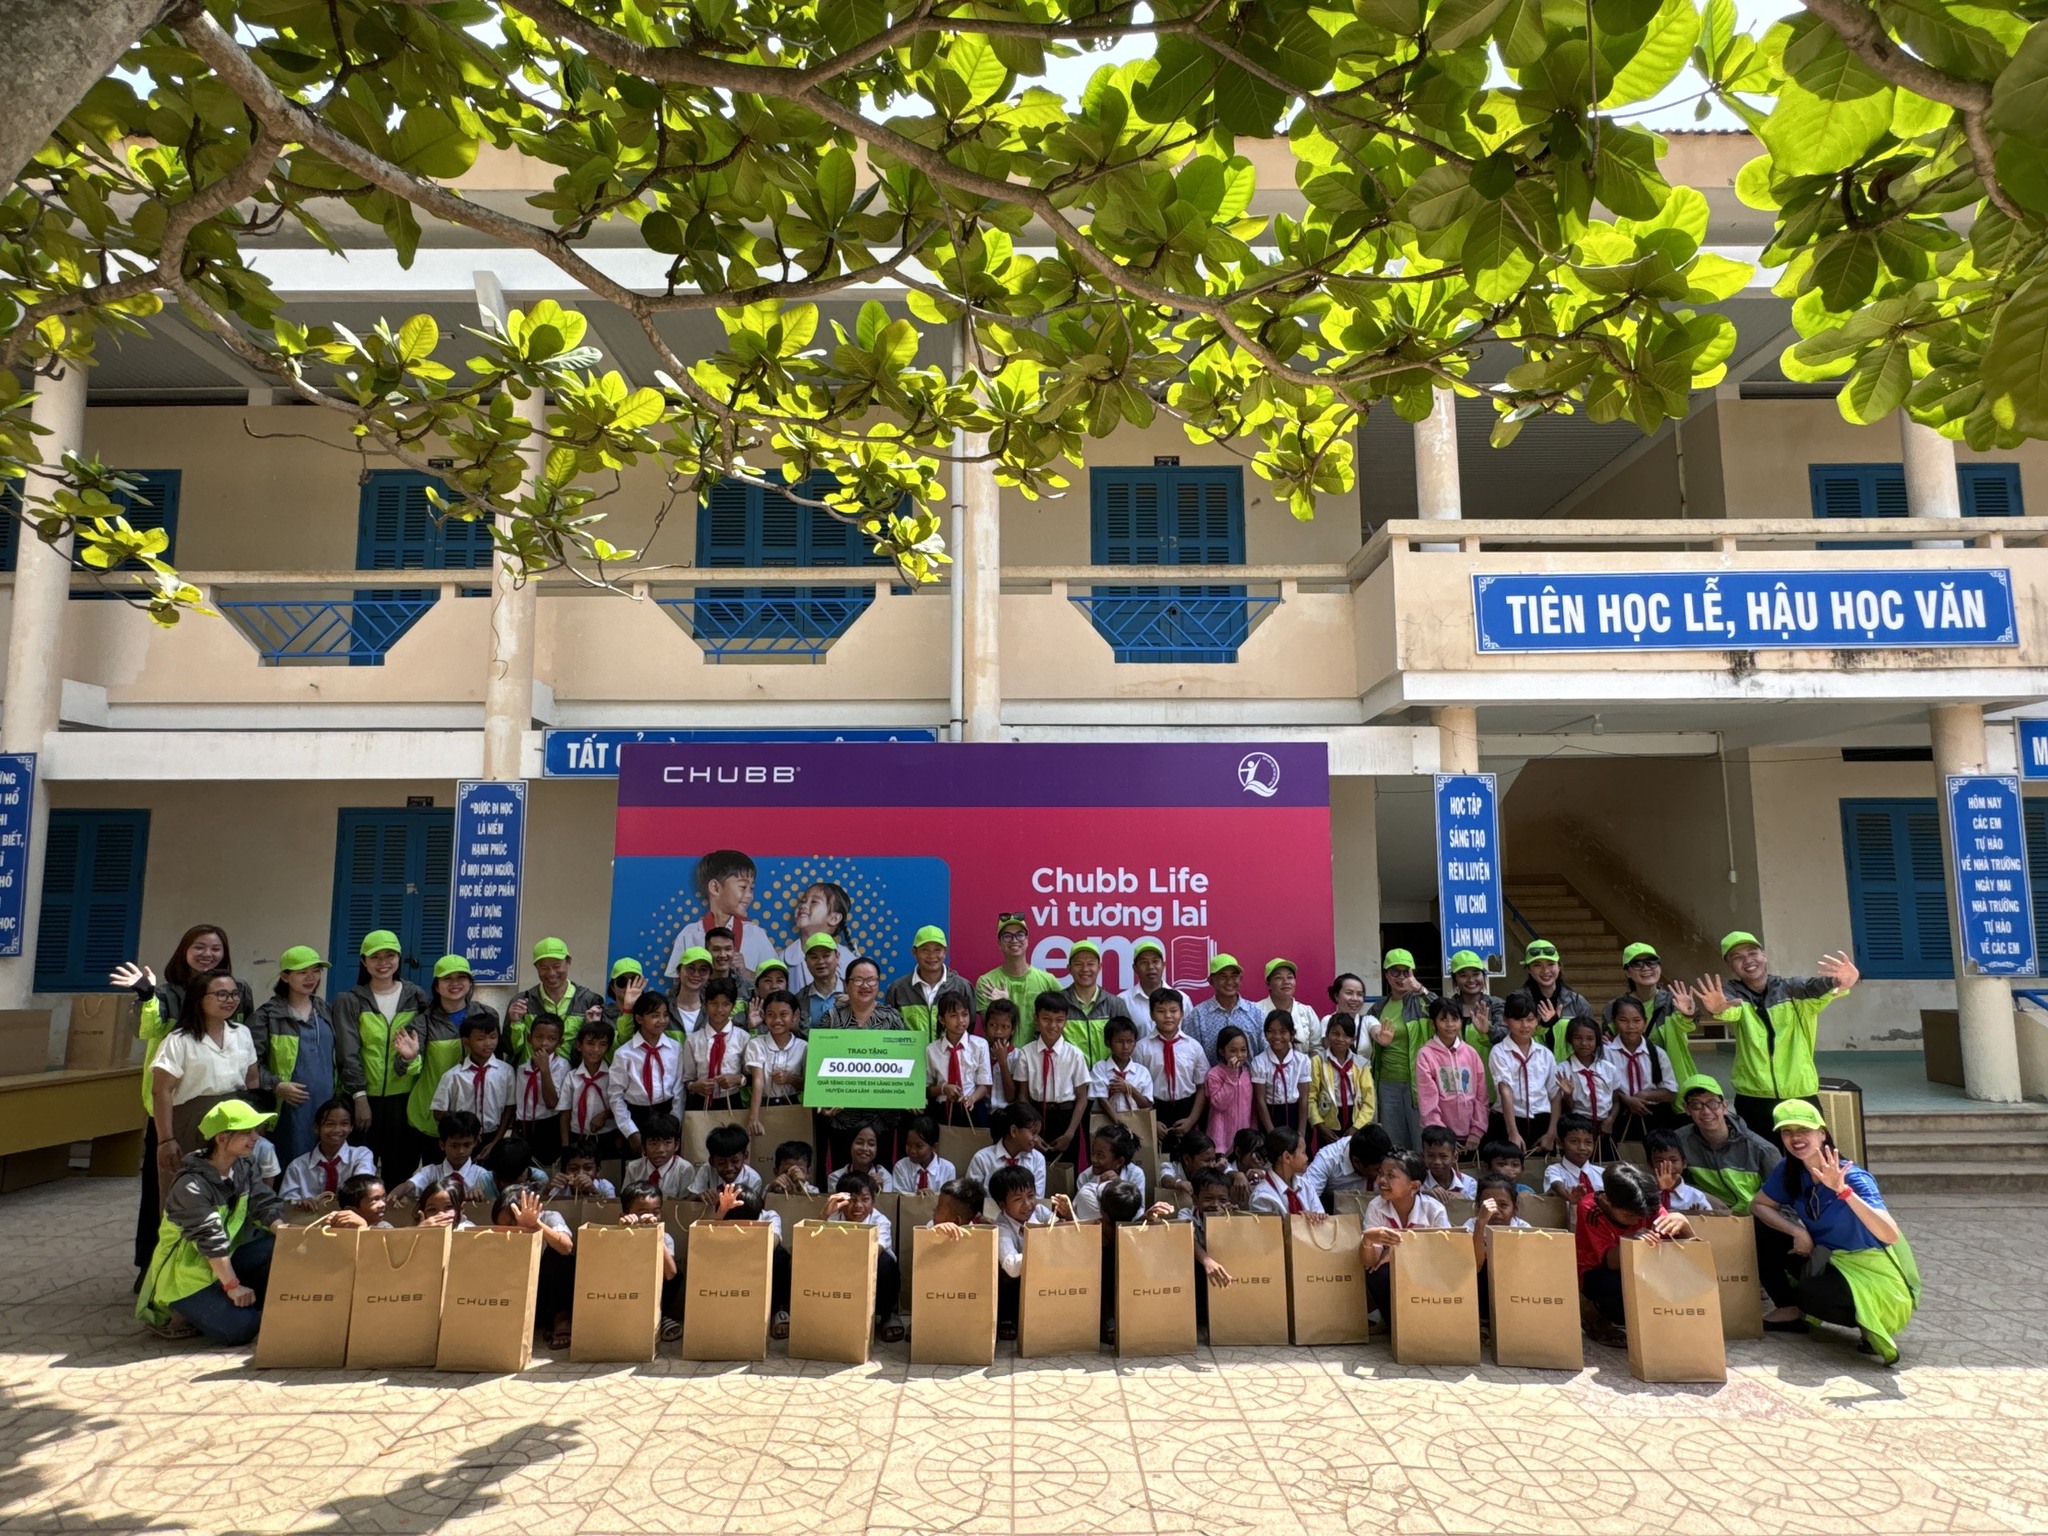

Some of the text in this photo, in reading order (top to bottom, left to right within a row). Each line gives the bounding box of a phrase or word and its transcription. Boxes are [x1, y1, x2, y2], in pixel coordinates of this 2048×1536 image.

[1506, 576, 1987, 642] TIÊN HỌC LỄ, HẬU HỌC VĂN
[567, 732, 609, 769] TẤT
[663, 766, 796, 783] CHUBB
[1450, 792, 1482, 820] HỌC TẬP
[1968, 794, 2002, 809] HÔM NAY
[500, 802, 514, 817] HỌC
[477, 819, 486, 835] LÀ
[1972, 814, 2002, 830] CÁC EM
[1450, 824, 1486, 852] SÁNG TẠO
[1987, 834, 2003, 850] HÀO
[471, 840, 508, 858] HẠNH PHÚC
[480, 864, 494, 876] CON
[1448, 857, 1490, 884] RÈN LUYỆN
[1973, 856, 1990, 871] NHÀ
[1031, 866, 1209, 894] Chubb Life
[1975, 876, 2012, 892] NGÀY MAI
[459, 884, 473, 899] HỌC
[484, 882, 497, 897] GÓP
[1454, 894, 1468, 914] VUI
[1972, 897, 1987, 913] NHÀ
[1031, 898, 1208, 931] vì tương lai
[1995, 917, 2012, 933] HÀO
[1450, 923, 1495, 950] LÀNH MẠNH
[1991, 938, 2006, 954] CÁC
[2007, 942, 2020, 954] EM
[869, 1048, 888, 1056] TẶNG
[1231, 1276, 1271, 1284] HUBB
[1306, 1275, 1352, 1283] CHUBB
[280, 1293, 334, 1302] CHUBB
[367, 1293, 423, 1304] CHUBB
[586, 1292, 639, 1300] CHUBB
[699, 1289, 751, 1298] CHUBB
[803, 1289, 853, 1300] CHUBB
[926, 1292, 977, 1300] CHUBB
[1038, 1288, 1089, 1297] CHUBB
[1133, 1286, 1182, 1297] CHUBB
[457, 1297, 510, 1307] CHUBB
[1410, 1296, 1463, 1305] CHUBB
[1510, 1295, 1565, 1305] CHUBB
[1652, 1307, 1706, 1316] CHUBB
